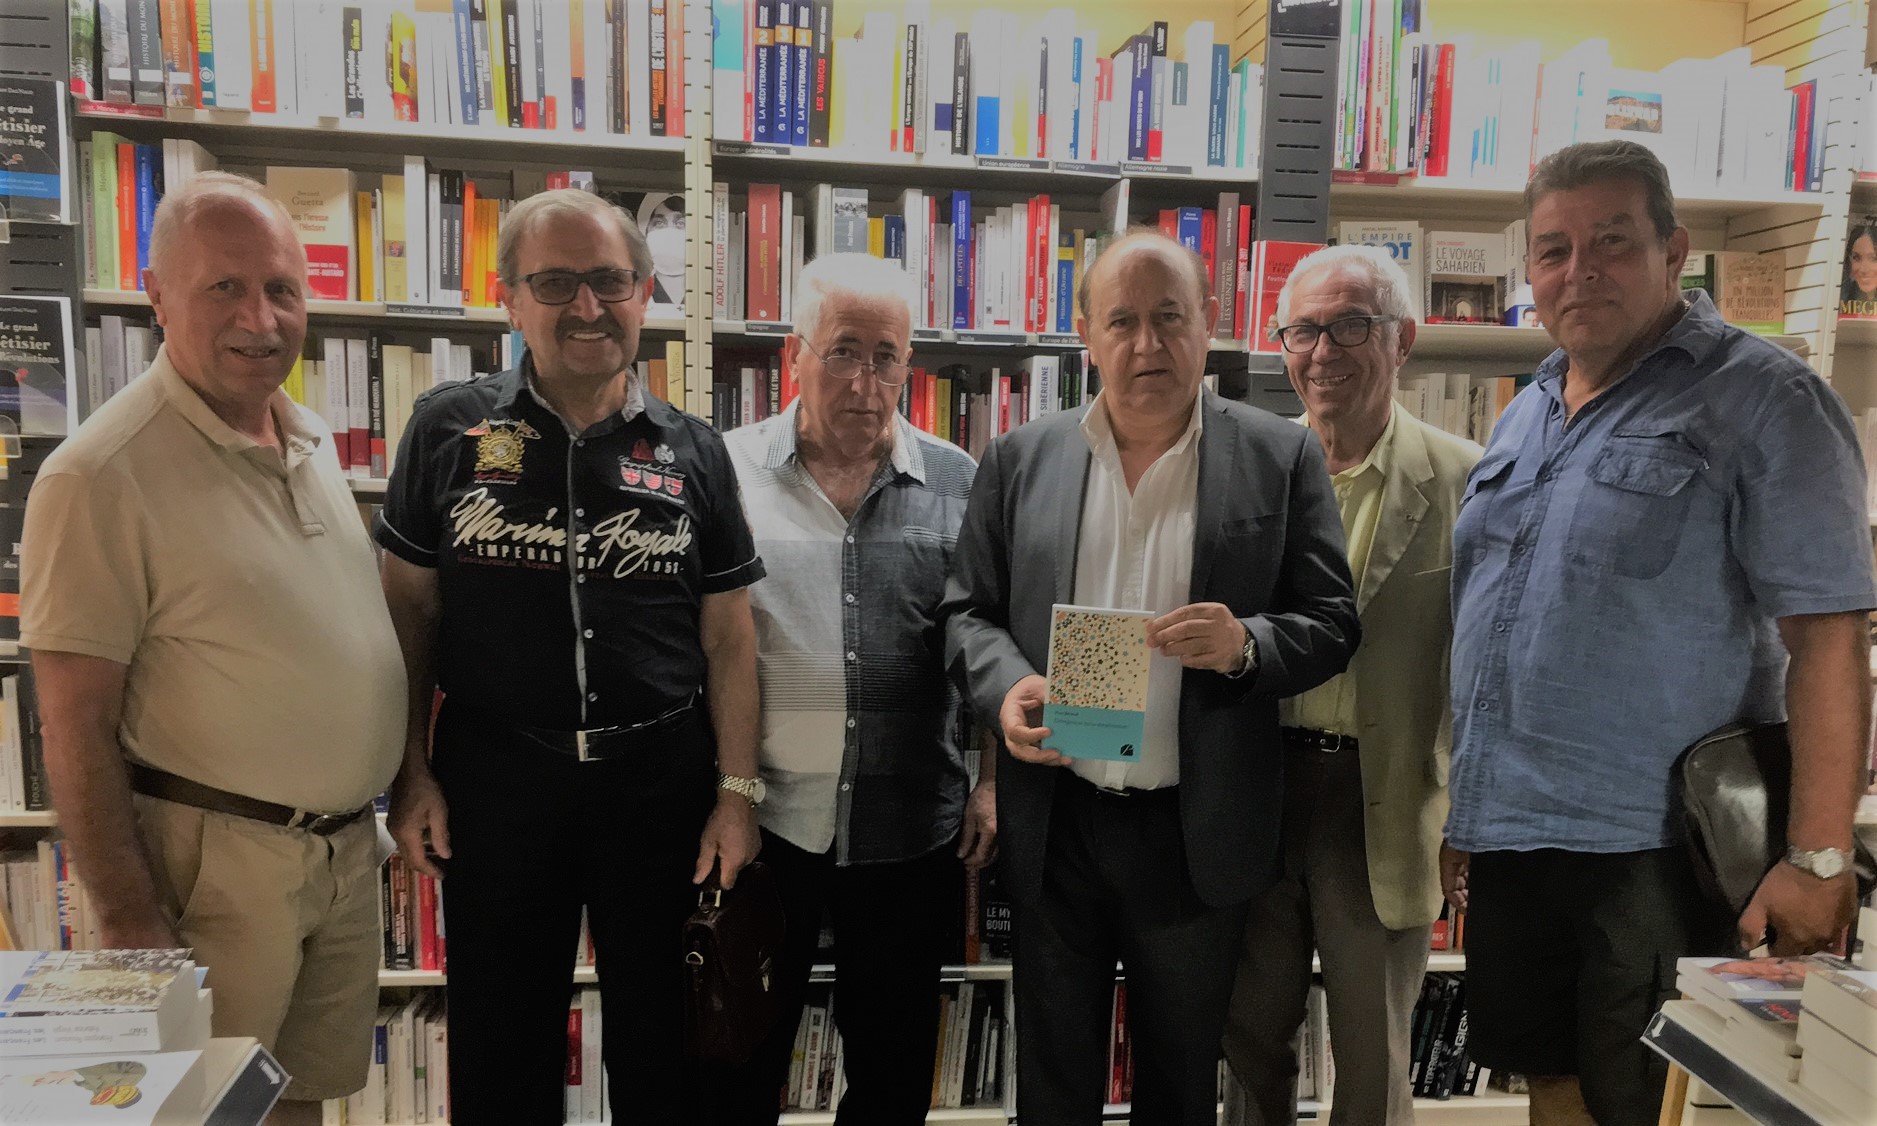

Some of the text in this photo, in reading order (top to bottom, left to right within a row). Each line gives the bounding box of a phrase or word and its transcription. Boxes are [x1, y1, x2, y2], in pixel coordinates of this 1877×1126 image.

[140, 20, 147, 31] DU
[141, 34, 150, 65] HISTOIRE
[171, 36, 179, 67] HISTOIRE
[652, 58, 664, 70] DE
[758, 48, 767, 108] MÉDITERRANÉE
[778, 45, 788, 118] LA MÉDITERRANÉE
[817, 58, 826, 93] VAINCUS
[8, 105, 34, 115] grand
[816, 97, 824, 110] LES
[759, 110, 766, 120] LA
[798, 110, 804, 120] LA
[956, 109, 962, 118] DE
[0, 117, 46, 136] tisier
[0, 134, 46, 150] oyen Âge
[292, 196, 324, 206] Guetta
[1348, 232, 1412, 242] L'EMPIRE
[1436, 248, 1486, 262] LE VOYAGE
[1436, 260, 1486, 274] SAHARIEN
[716, 243, 724, 306] ADOLF HITLER
[1224, 259, 1233, 304] GUNZBURG
[14, 324, 38, 334] grand
[0, 334, 51, 350] êtisier
[1040, 366, 1048, 411] SIBÉRIENNE
[986, 907, 997, 918] LE
